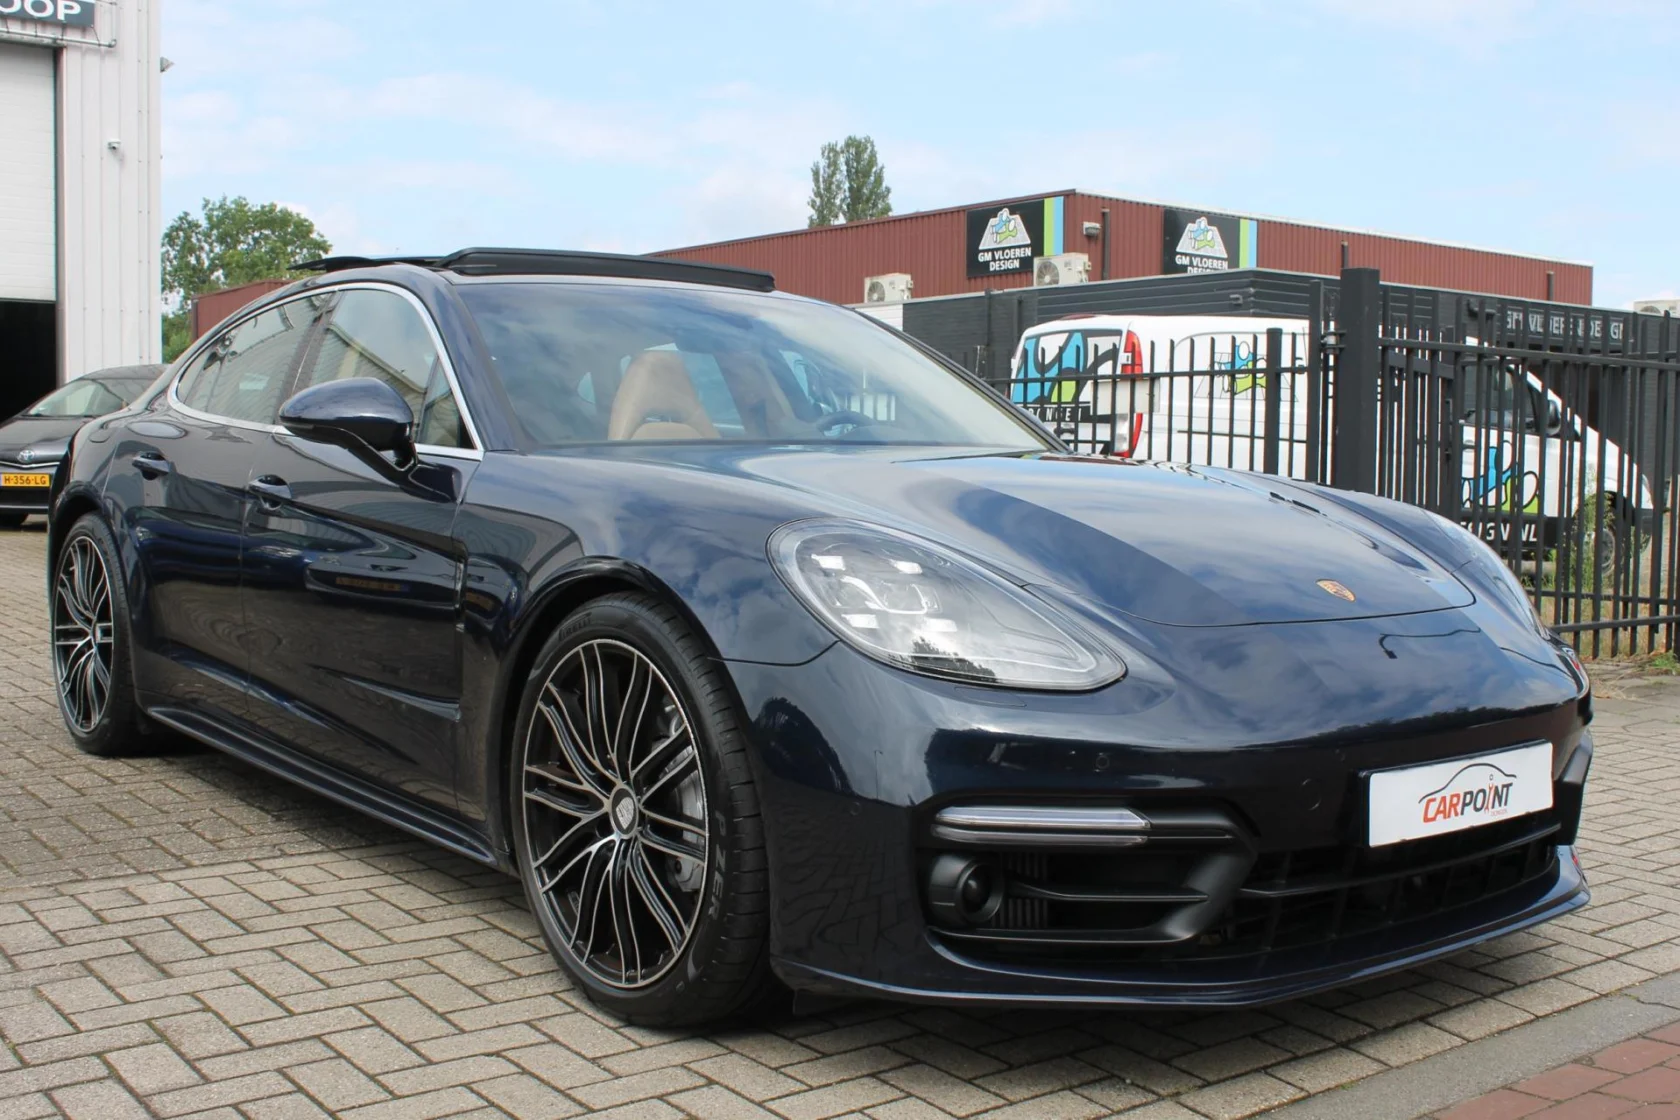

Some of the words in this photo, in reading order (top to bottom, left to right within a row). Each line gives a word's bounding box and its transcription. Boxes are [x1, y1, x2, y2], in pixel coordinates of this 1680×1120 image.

[978, 252, 992, 262] GM
[994, 247, 1031, 260] VLOEREN
[990, 259, 1019, 271] DESIGN
[1175, 255, 1189, 265] GM
[1192, 256, 1228, 270] VLOEREN
[1423, 782, 1513, 823] CARPOINT
